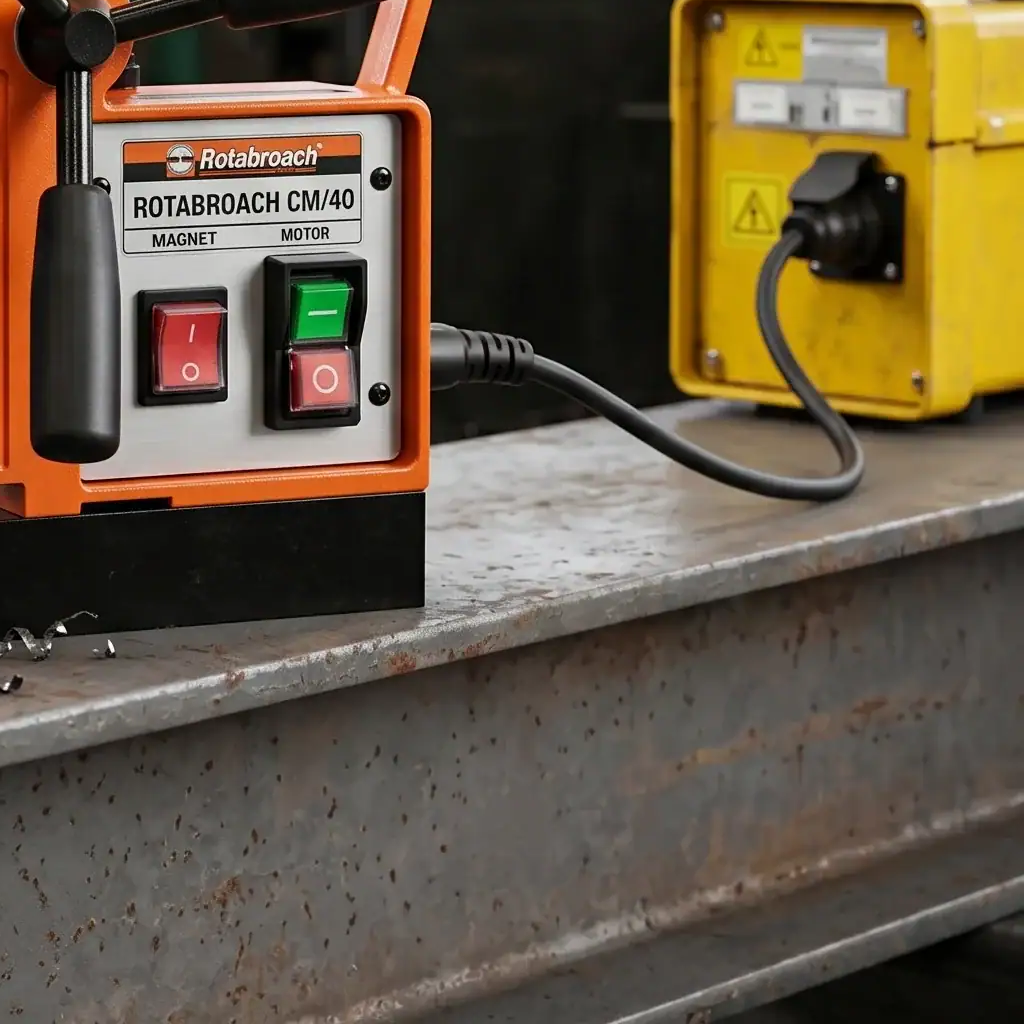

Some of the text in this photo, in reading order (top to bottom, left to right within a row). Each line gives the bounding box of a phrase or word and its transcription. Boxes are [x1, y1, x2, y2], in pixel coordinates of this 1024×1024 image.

[199, 144, 318, 170] Rotabroach
[133, 188, 355, 219] ROTABROACH CM/40
[152, 231, 218, 248] MAGNET
[281, 226, 330, 242] MOTOR
